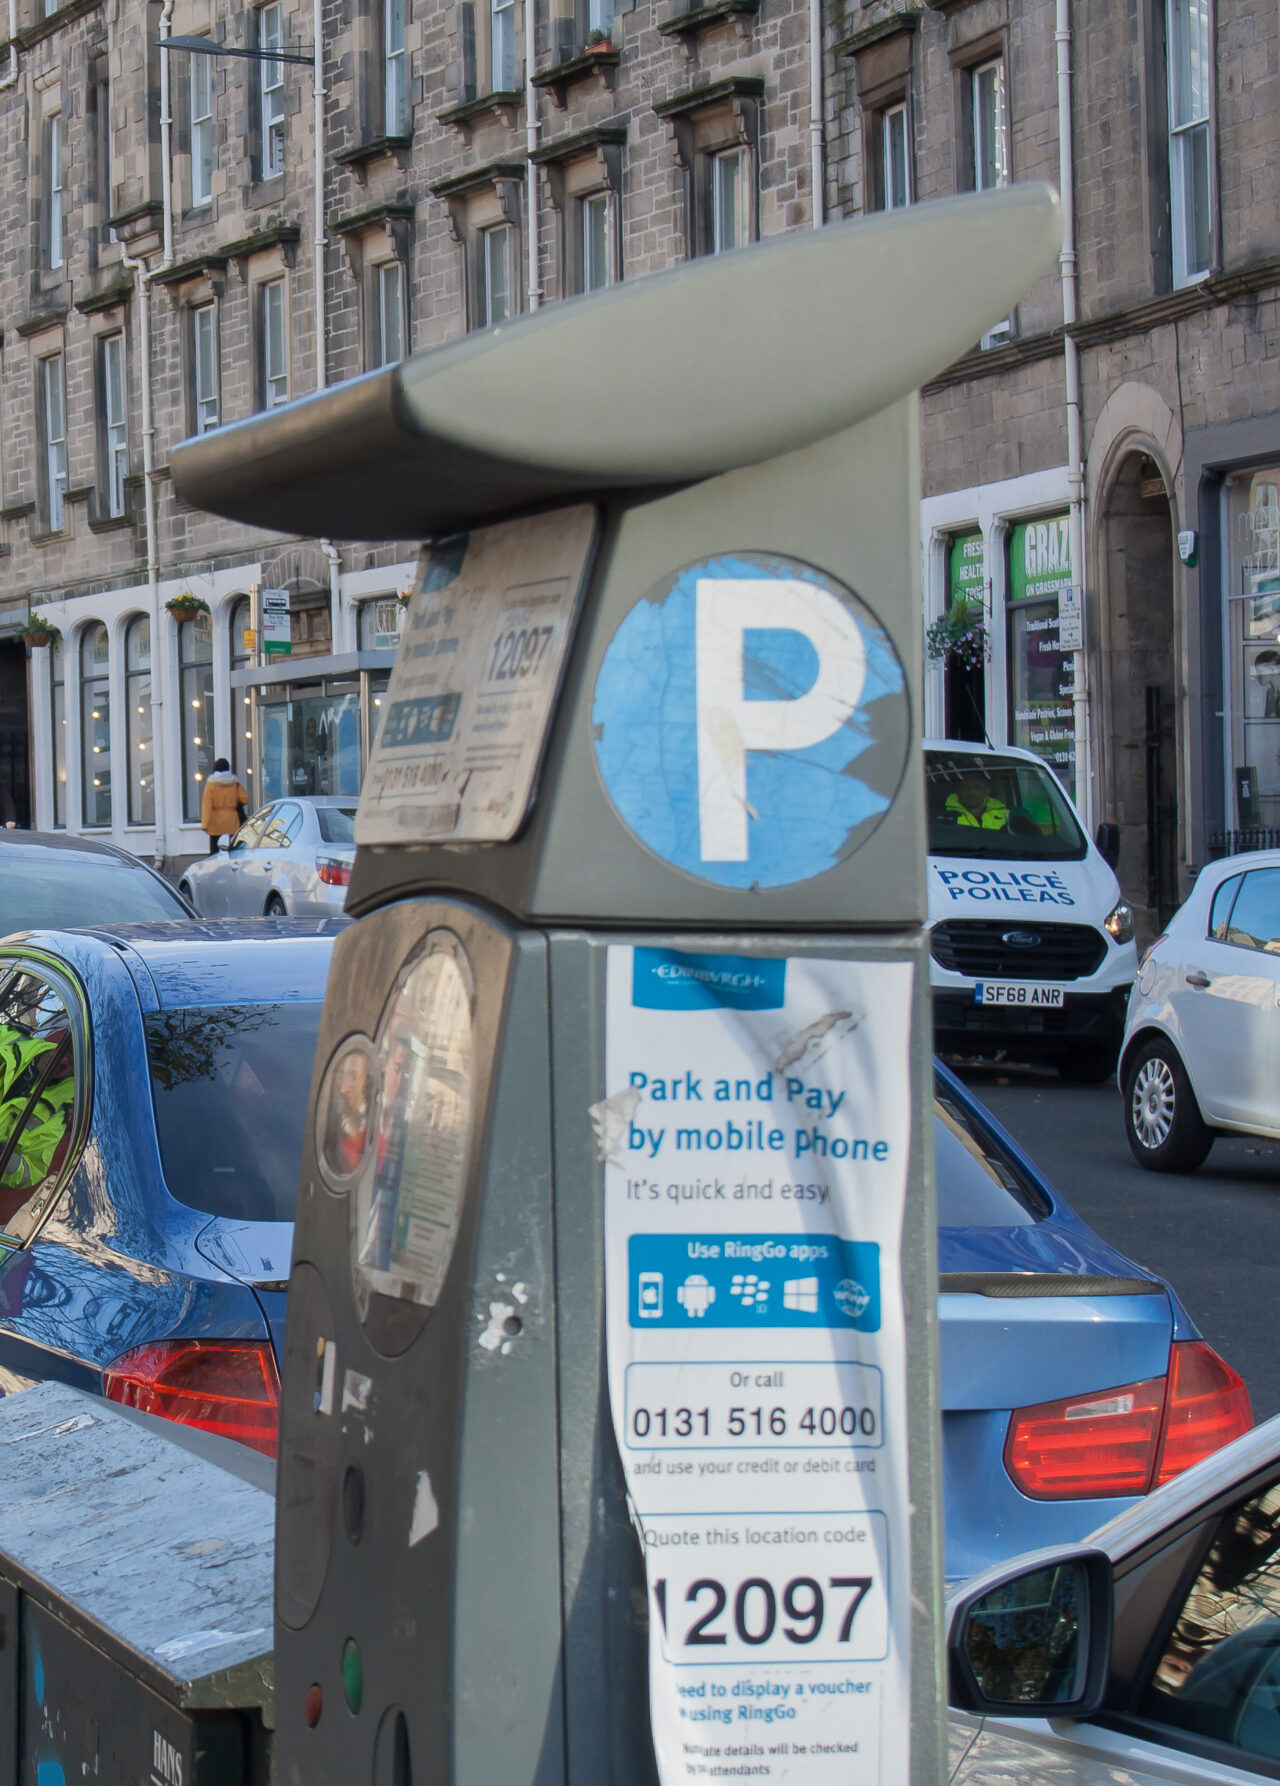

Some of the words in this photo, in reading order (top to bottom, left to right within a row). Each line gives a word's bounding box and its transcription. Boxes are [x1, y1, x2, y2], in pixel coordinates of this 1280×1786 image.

[1024, 518, 1072, 578] GRAZ
[1025, 583, 1035, 597] ON
[487, 626, 555, 681] 12097
[937, 870, 1067, 890] POLICE
[948, 887, 1075, 906] POILEAS
[985, 986, 1026, 1003] SF68
[1031, 988, 1061, 1004] ANR
[629, 1071, 704, 1101] Park
[714, 1072, 773, 1102] and
[786, 1078, 846, 1118] Pay
[628, 1119, 665, 1159] by
[675, 1120, 784, 1151] mobile
[794, 1126, 889, 1162] phone
[627, 1178, 660, 1200] It's
[666, 1178, 726, 1204] quick
[732, 1179, 773, 1200] and
[780, 1182, 830, 1204] easy
[687, 1242, 720, 1258] Use
[724, 1241, 786, 1262] RingGo
[789, 1244, 829, 1262] apps
[729, 1371, 749, 1388] Or
[755, 1371, 784, 1388] call
[633, 1407, 710, 1437] 0131
[727, 1406, 787, 1437] 516
[798, 1406, 876, 1436] 4000
[633, 1459, 662, 1474] and
[666, 1462, 693, 1474] use
[698, 1461, 733, 1477] your
[736, 1458, 779, 1473] credit
[784, 1461, 799, 1473] or
[802, 1458, 840, 1473] debit
[844, 1457, 876, 1472] card
[643, 1529, 700, 1547] Quote
[706, 1528, 740, 1545] this
[746, 1527, 817, 1545] location
[823, 1526, 866, 1543] code
[676, 1683, 707, 1698] eed
[711, 1684, 727, 1698] to
[731, 1680, 791, 1701] display
[795, 1684, 804, 1696] a
[808, 1679, 873, 1696] voucher
[690, 1706, 733, 1725] using
[737, 1704, 797, 1724] RingGo
[153, 1729, 183, 1786] HANS
[724, 1744, 765, 1757] details
[768, 1743, 789, 1755] will
[792, 1743, 806, 1755] be
[810, 1741, 859, 1754] checked
